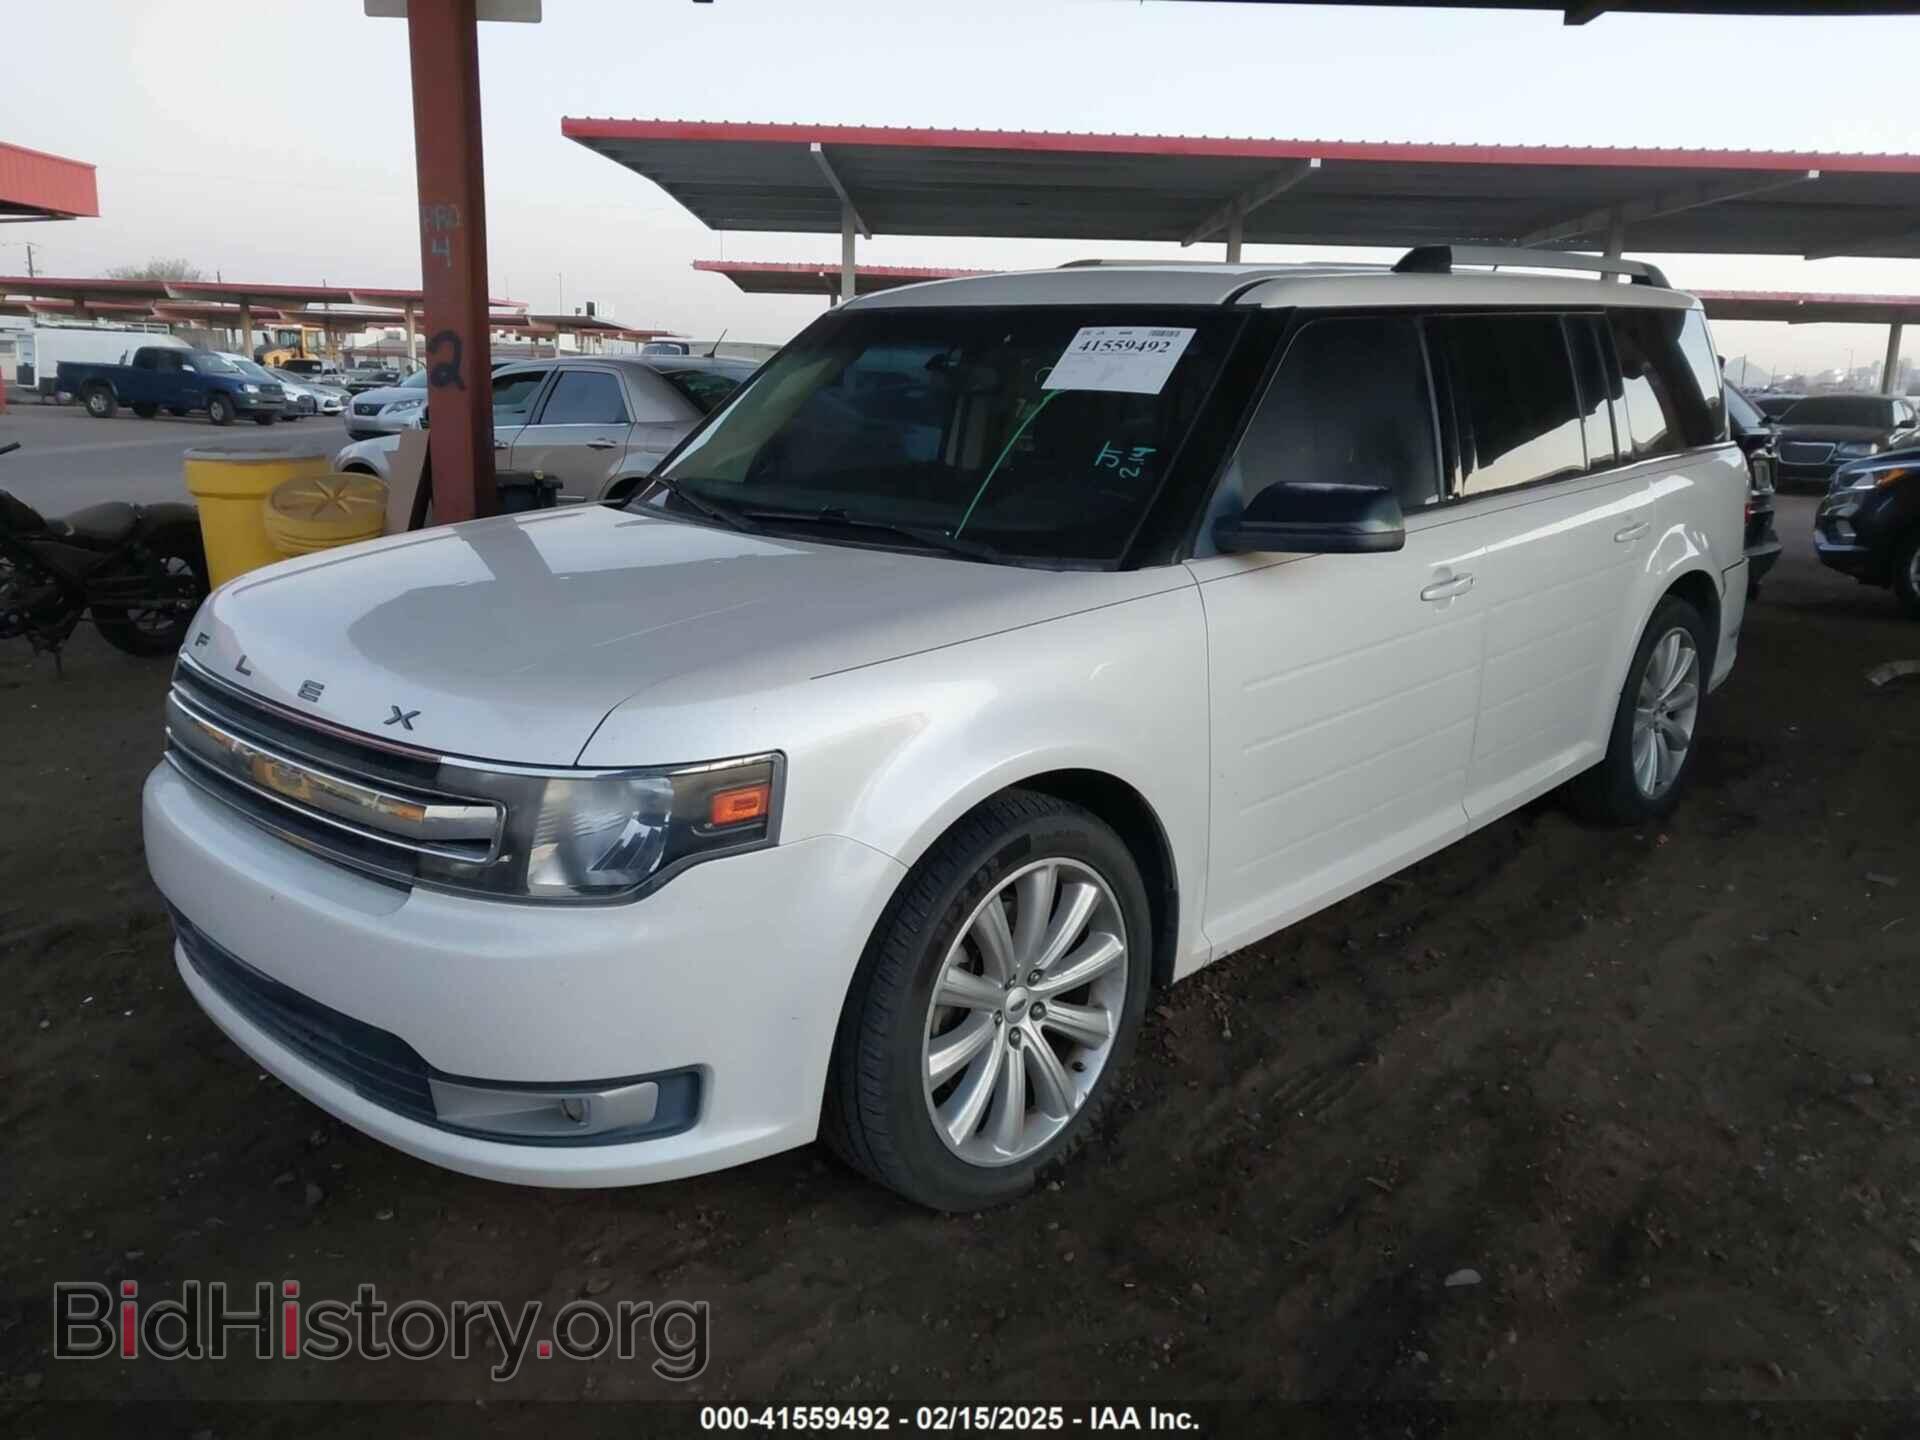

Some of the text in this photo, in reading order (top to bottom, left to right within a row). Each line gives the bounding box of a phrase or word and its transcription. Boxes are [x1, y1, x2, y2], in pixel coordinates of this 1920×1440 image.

[431, 236, 453, 269] 4
[429, 329, 465, 390] 2
[1078, 339, 1171, 353] 41559492
[194, 631, 421, 731] FLEX
